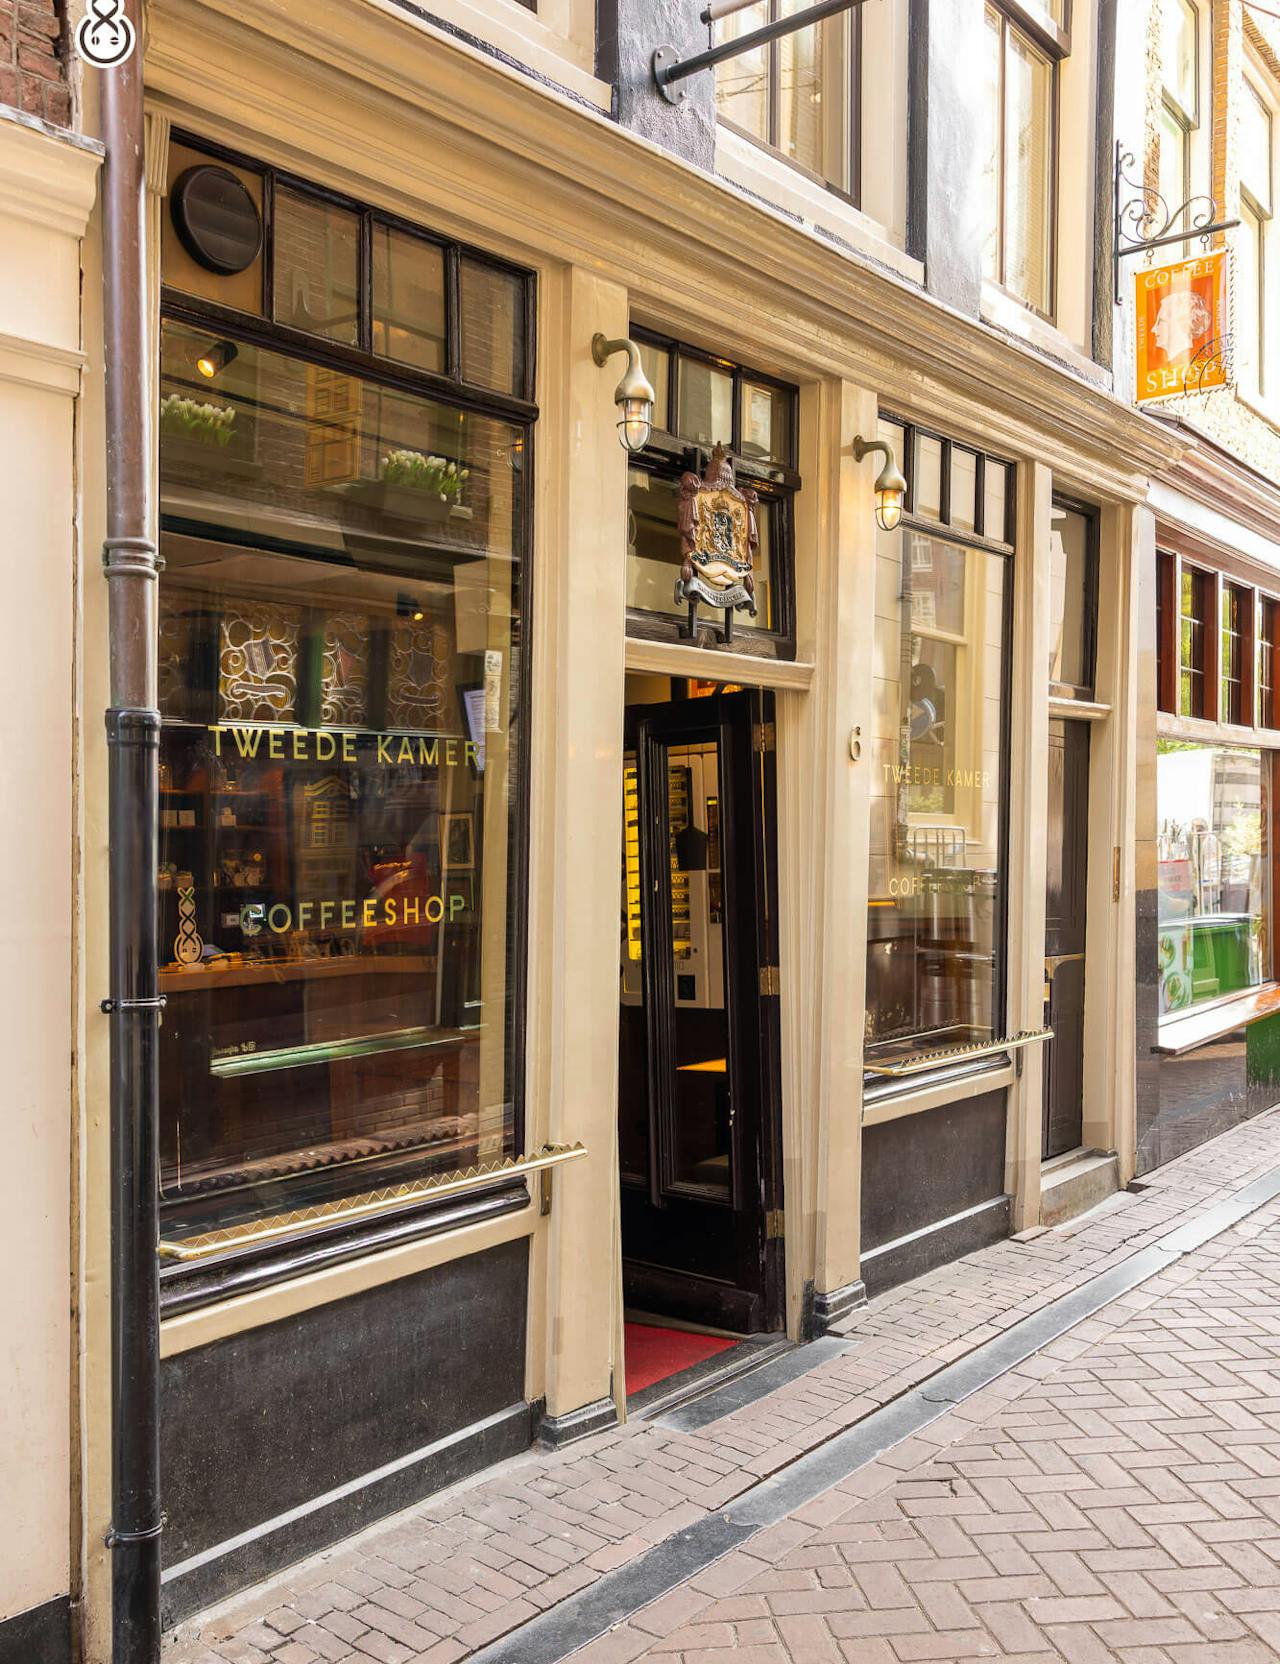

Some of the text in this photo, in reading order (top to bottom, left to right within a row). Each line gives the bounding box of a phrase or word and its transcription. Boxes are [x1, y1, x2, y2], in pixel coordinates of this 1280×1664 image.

[1144, 260, 1214, 289] COFFEE
[1146, 361, 1216, 393] SHOP
[207, 726, 482, 767] TWEEDE KAMER
[849, 726, 862, 762] 6
[882, 764, 991, 788] TWEEDE KAMER
[239, 895, 465, 935] COFFEESHOP
